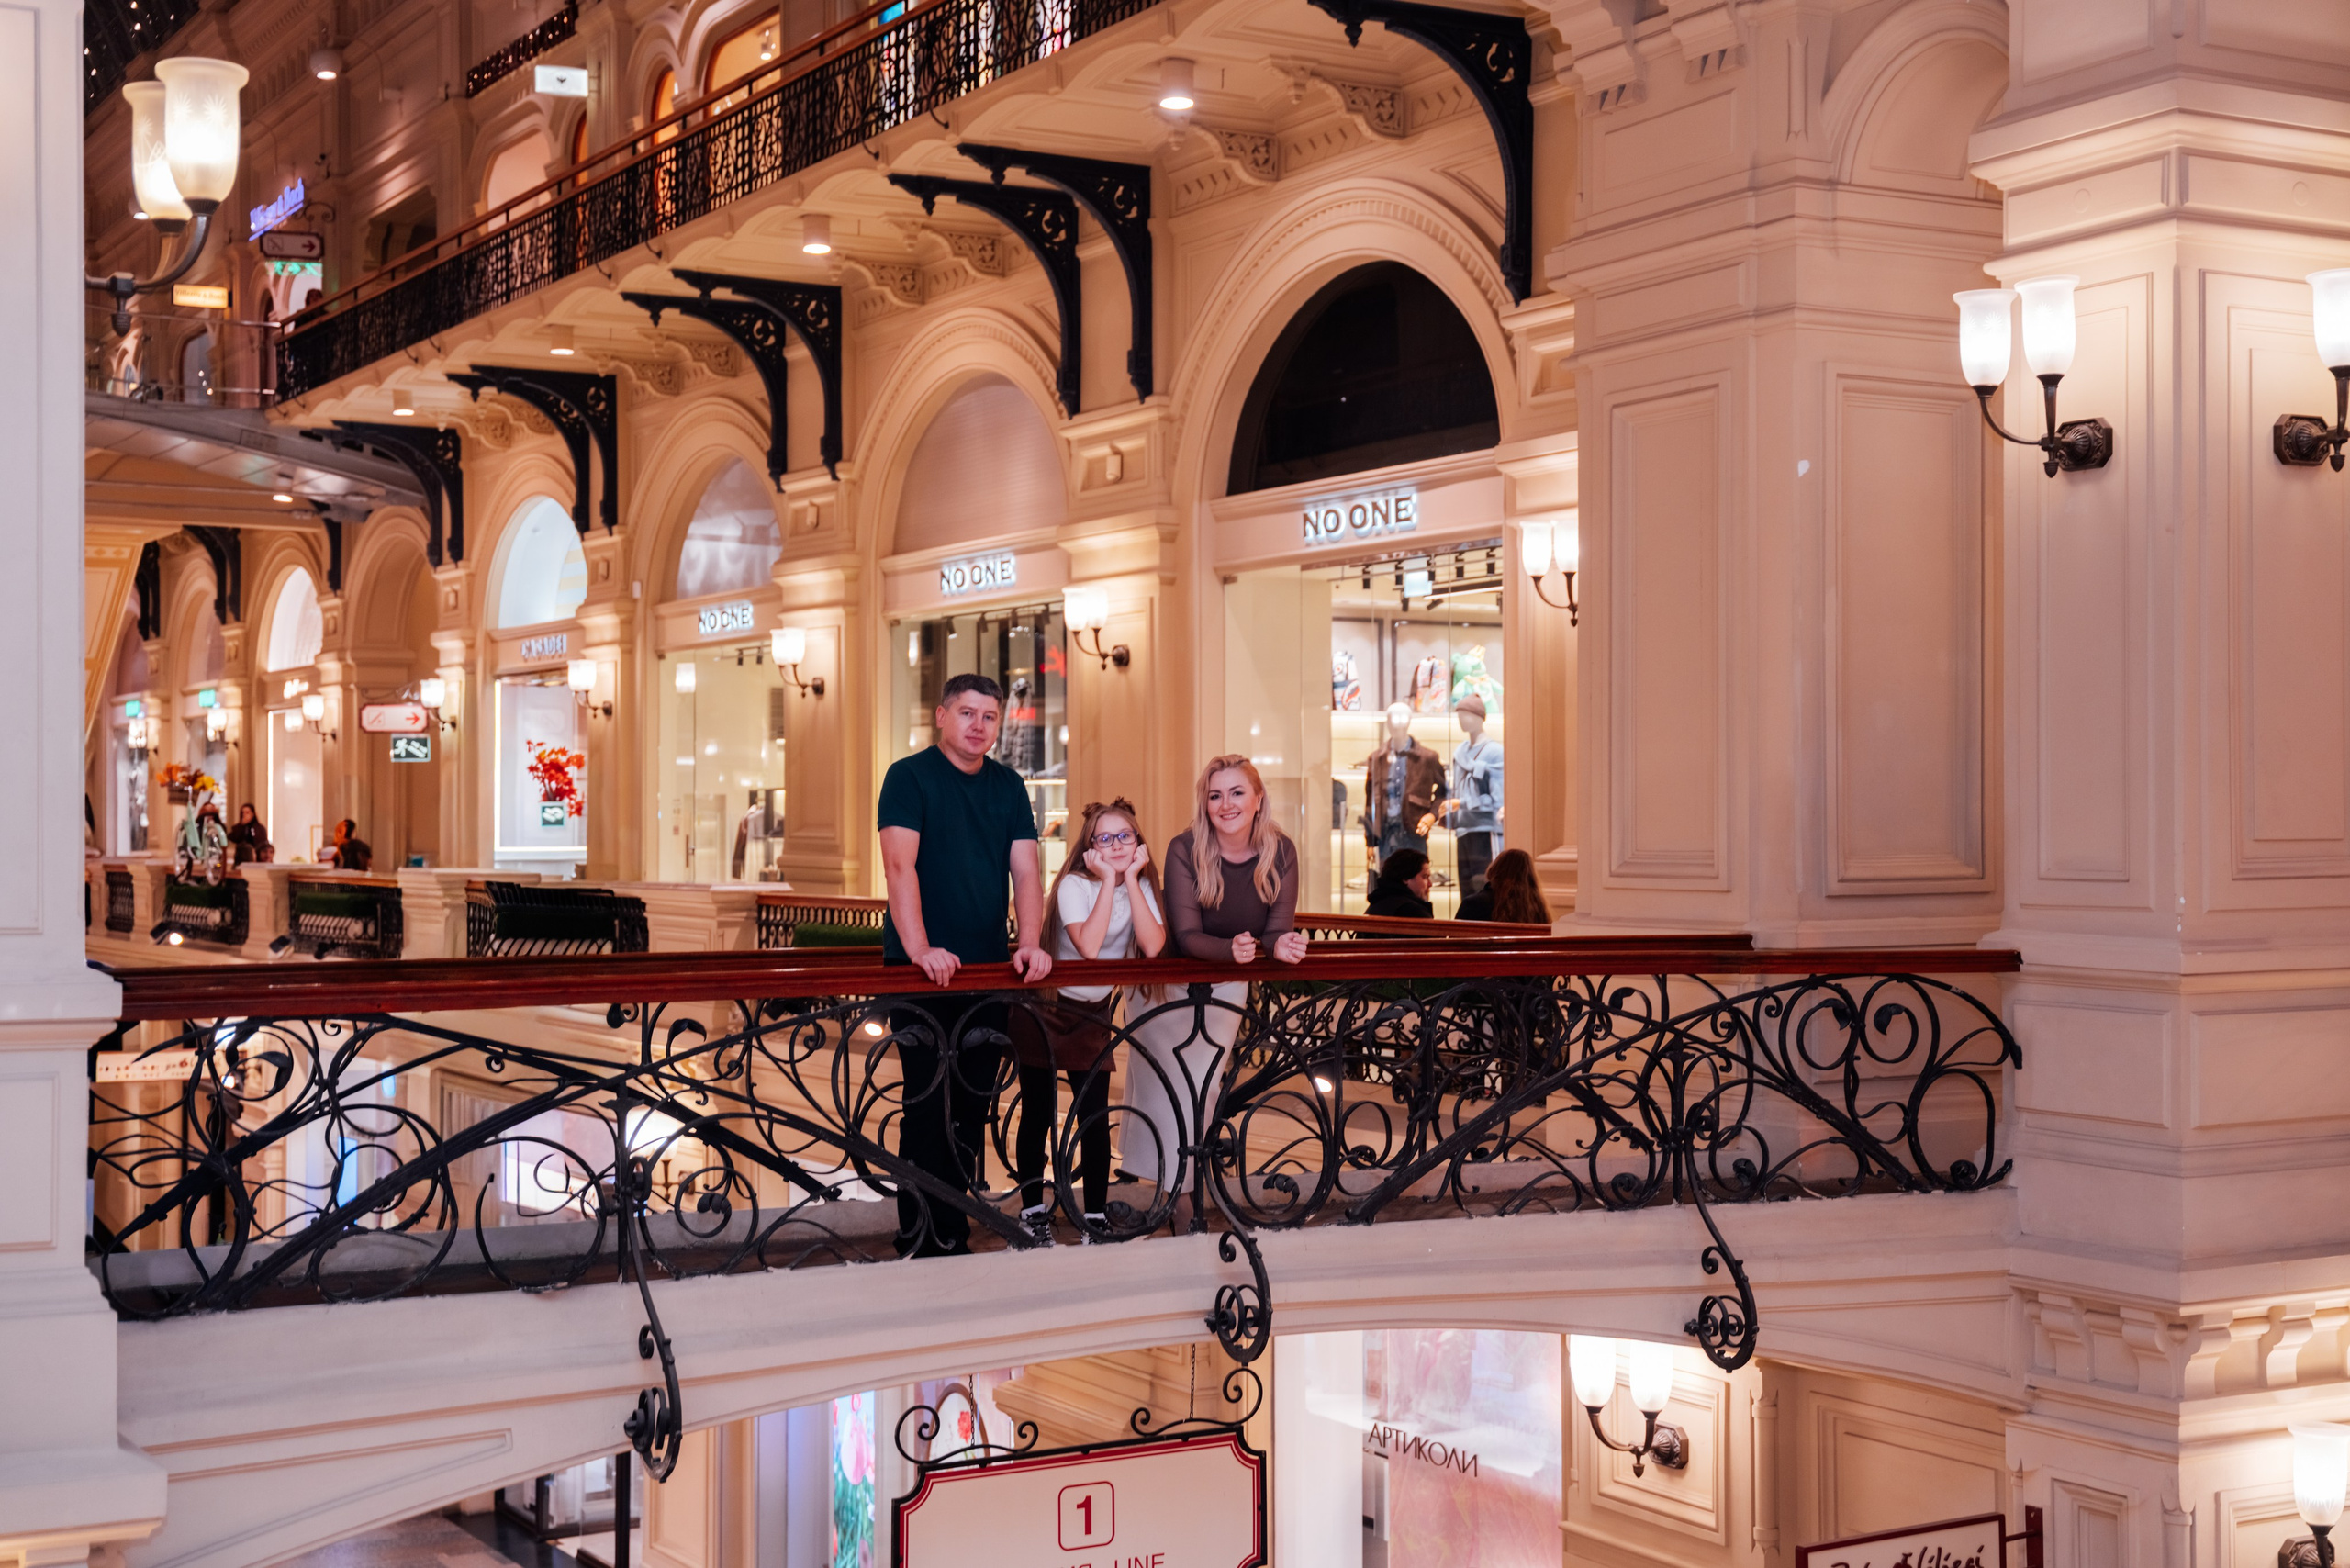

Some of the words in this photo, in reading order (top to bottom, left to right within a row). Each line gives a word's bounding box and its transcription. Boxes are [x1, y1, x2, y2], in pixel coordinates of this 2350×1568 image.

[1304, 509, 1343, 539] NO
[1349, 496, 1415, 531] ONE
[940, 566, 968, 592] NO
[971, 558, 1013, 588] ONE
[699, 611, 719, 632] NO
[721, 606, 752, 629] ONE
[1368, 1423, 1478, 1477] АРТИКОЛИ
[1076, 1495, 1092, 1536] 1
